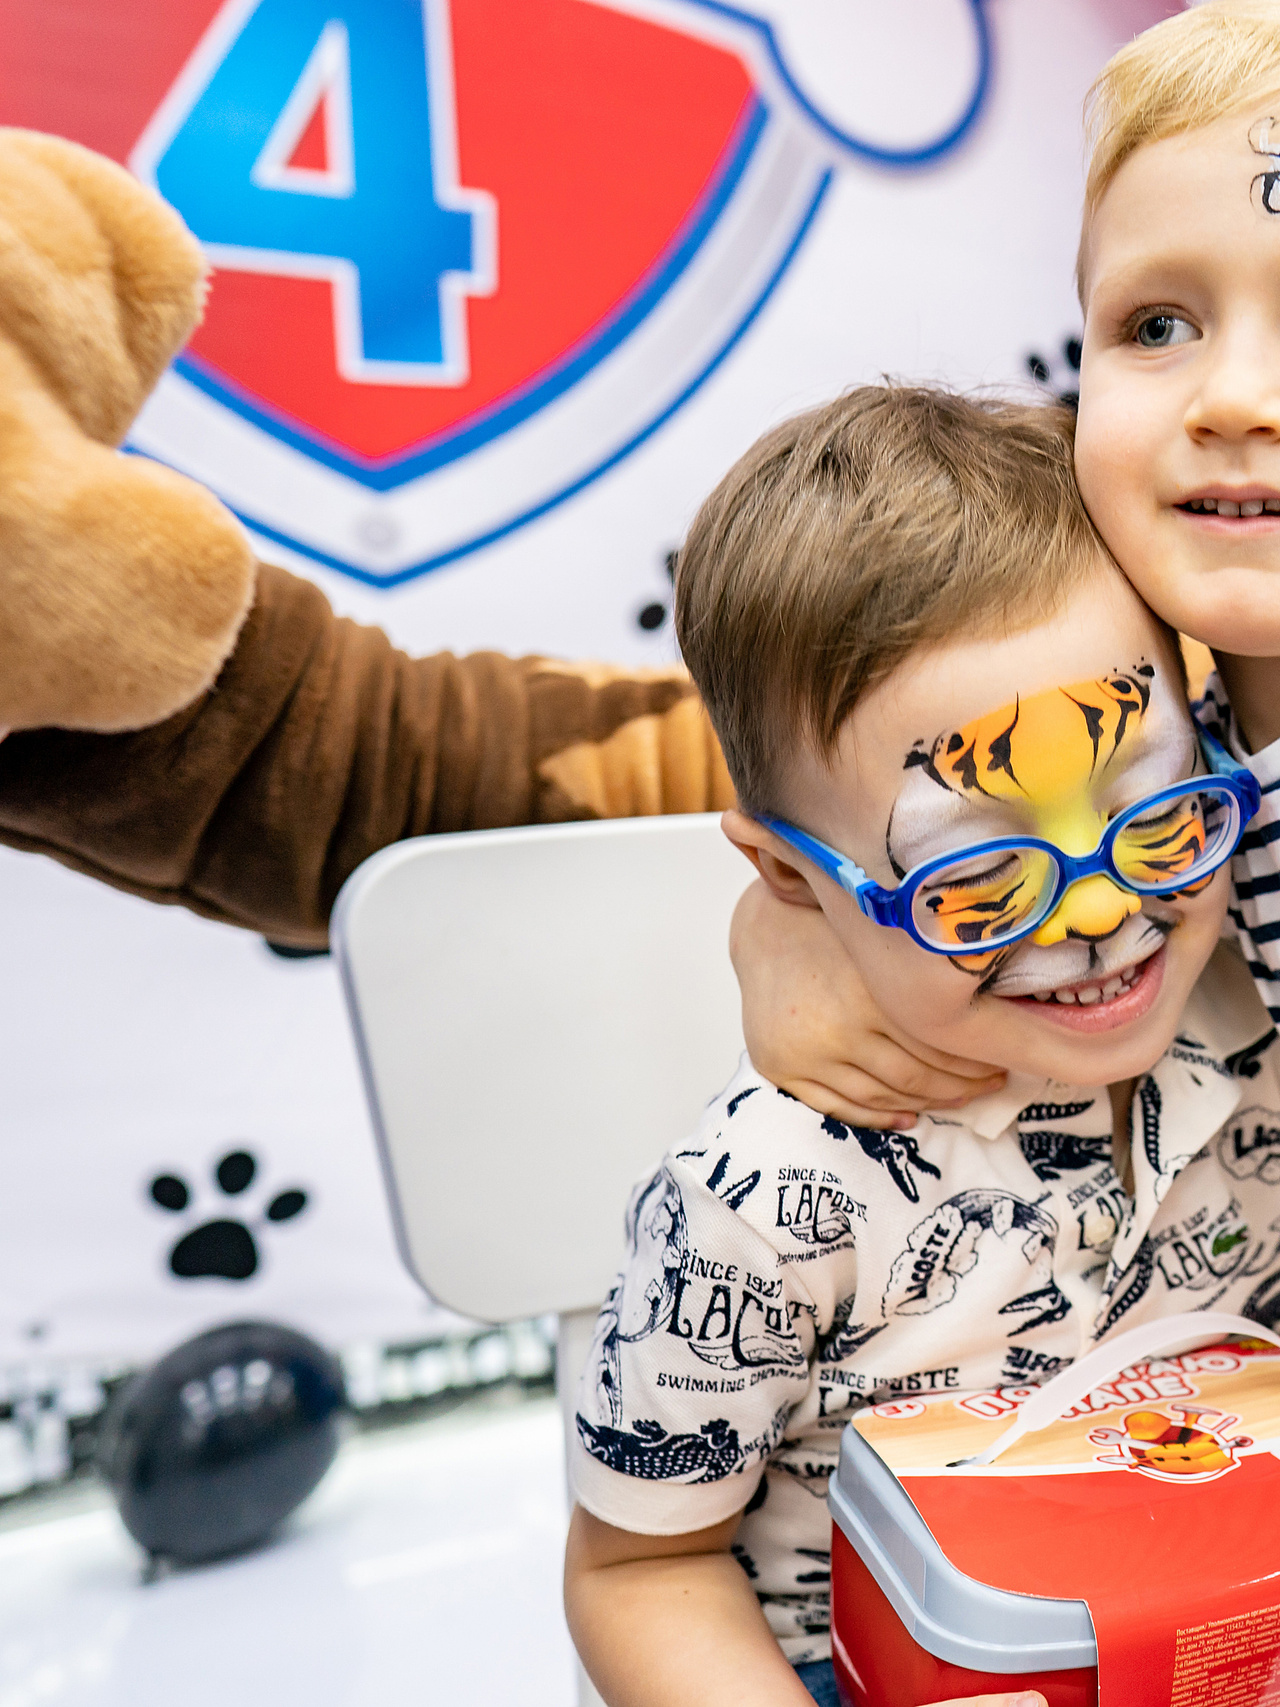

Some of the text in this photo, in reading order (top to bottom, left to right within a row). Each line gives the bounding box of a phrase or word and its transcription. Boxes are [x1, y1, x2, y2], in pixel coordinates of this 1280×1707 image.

[145, 0, 482, 372] 4
[656, 1373, 745, 1393] SWIMMING
[819, 1367, 867, 1390] SINCE
